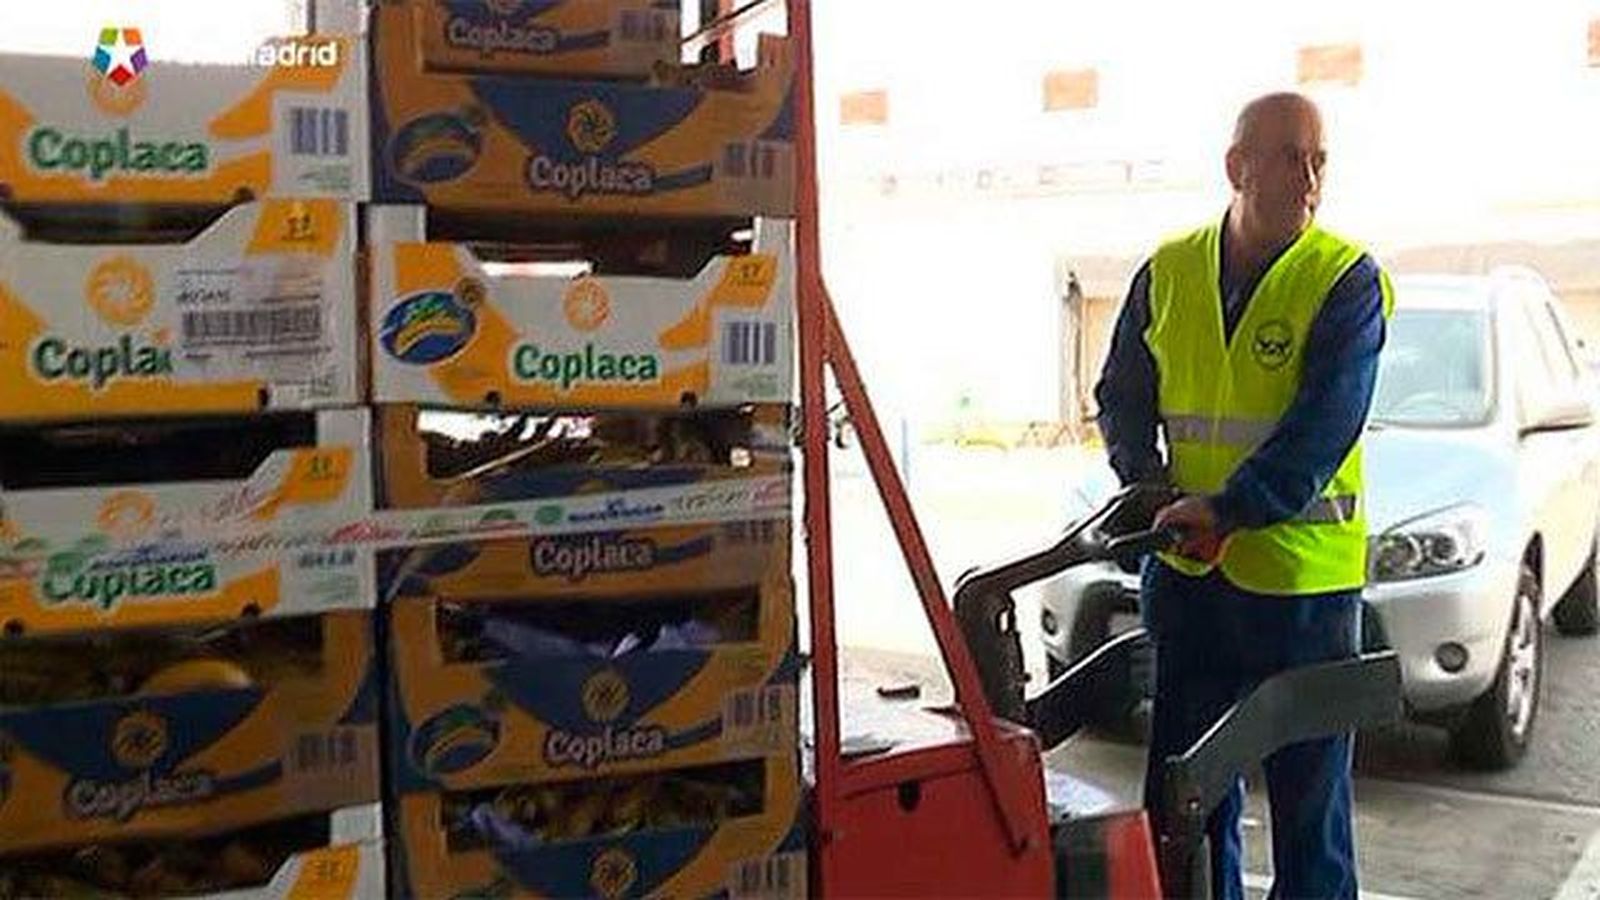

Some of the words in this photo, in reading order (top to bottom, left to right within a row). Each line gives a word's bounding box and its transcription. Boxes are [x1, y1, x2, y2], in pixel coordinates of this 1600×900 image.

[29, 127, 209, 181] Coplaca
[529, 155, 655, 198] Coplaca
[513, 344, 659, 389] Coplaca
[533, 537, 654, 577] Coplaca
[546, 726, 666, 767] Coplaca
